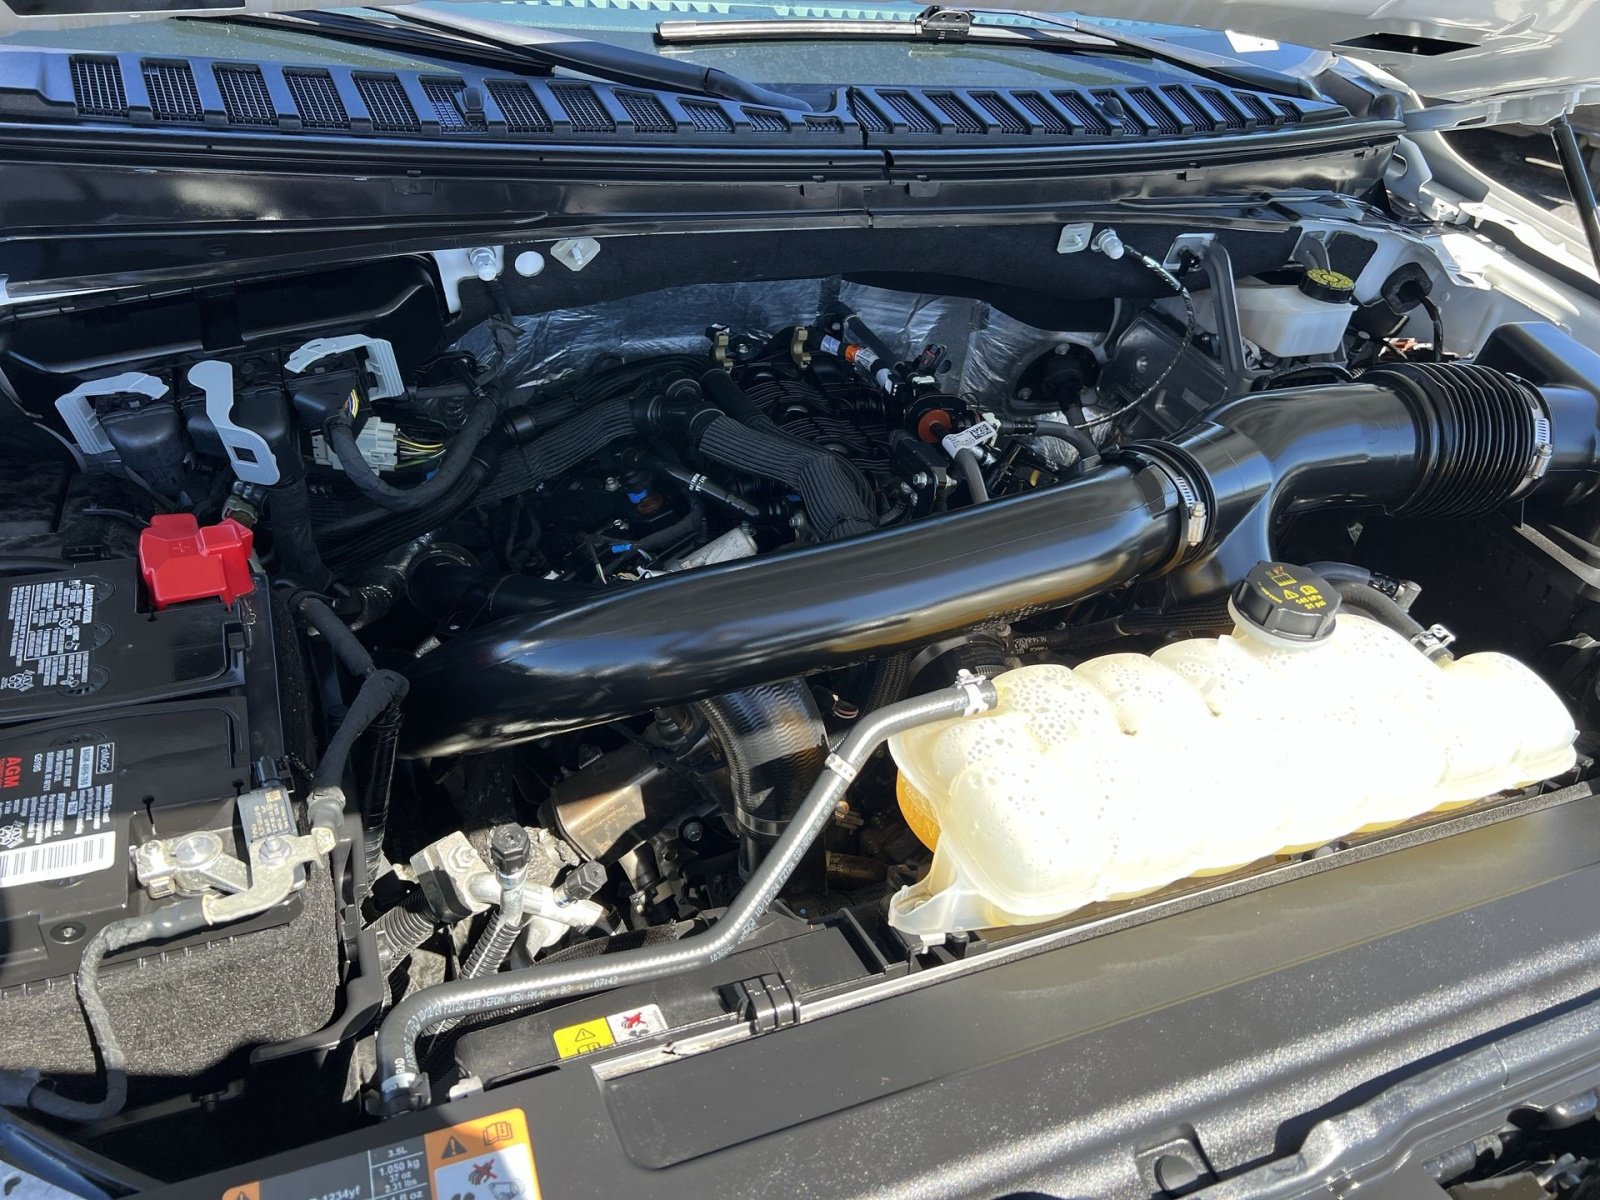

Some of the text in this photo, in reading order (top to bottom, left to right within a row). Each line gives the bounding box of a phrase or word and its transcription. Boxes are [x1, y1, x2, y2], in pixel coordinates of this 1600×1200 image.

[99, 744, 110, 772] FoMoCo
[3, 757, 22, 788] AGM
[754, 883, 780, 917] 10/12/24
[467, 1000, 481, 1010] CIP
[396, 1057, 406, 1074] RAD
[388, 1146, 408, 1158] 3.5L
[380, 1159, 420, 1176] 1.050 kg
[389, 1171, 412, 1182] 37 oz
[308, 1184, 360, 1200] 1234yf
[384, 1178, 417, 1193] 2.31 lbs
[410, 1190, 423, 1200] oz
